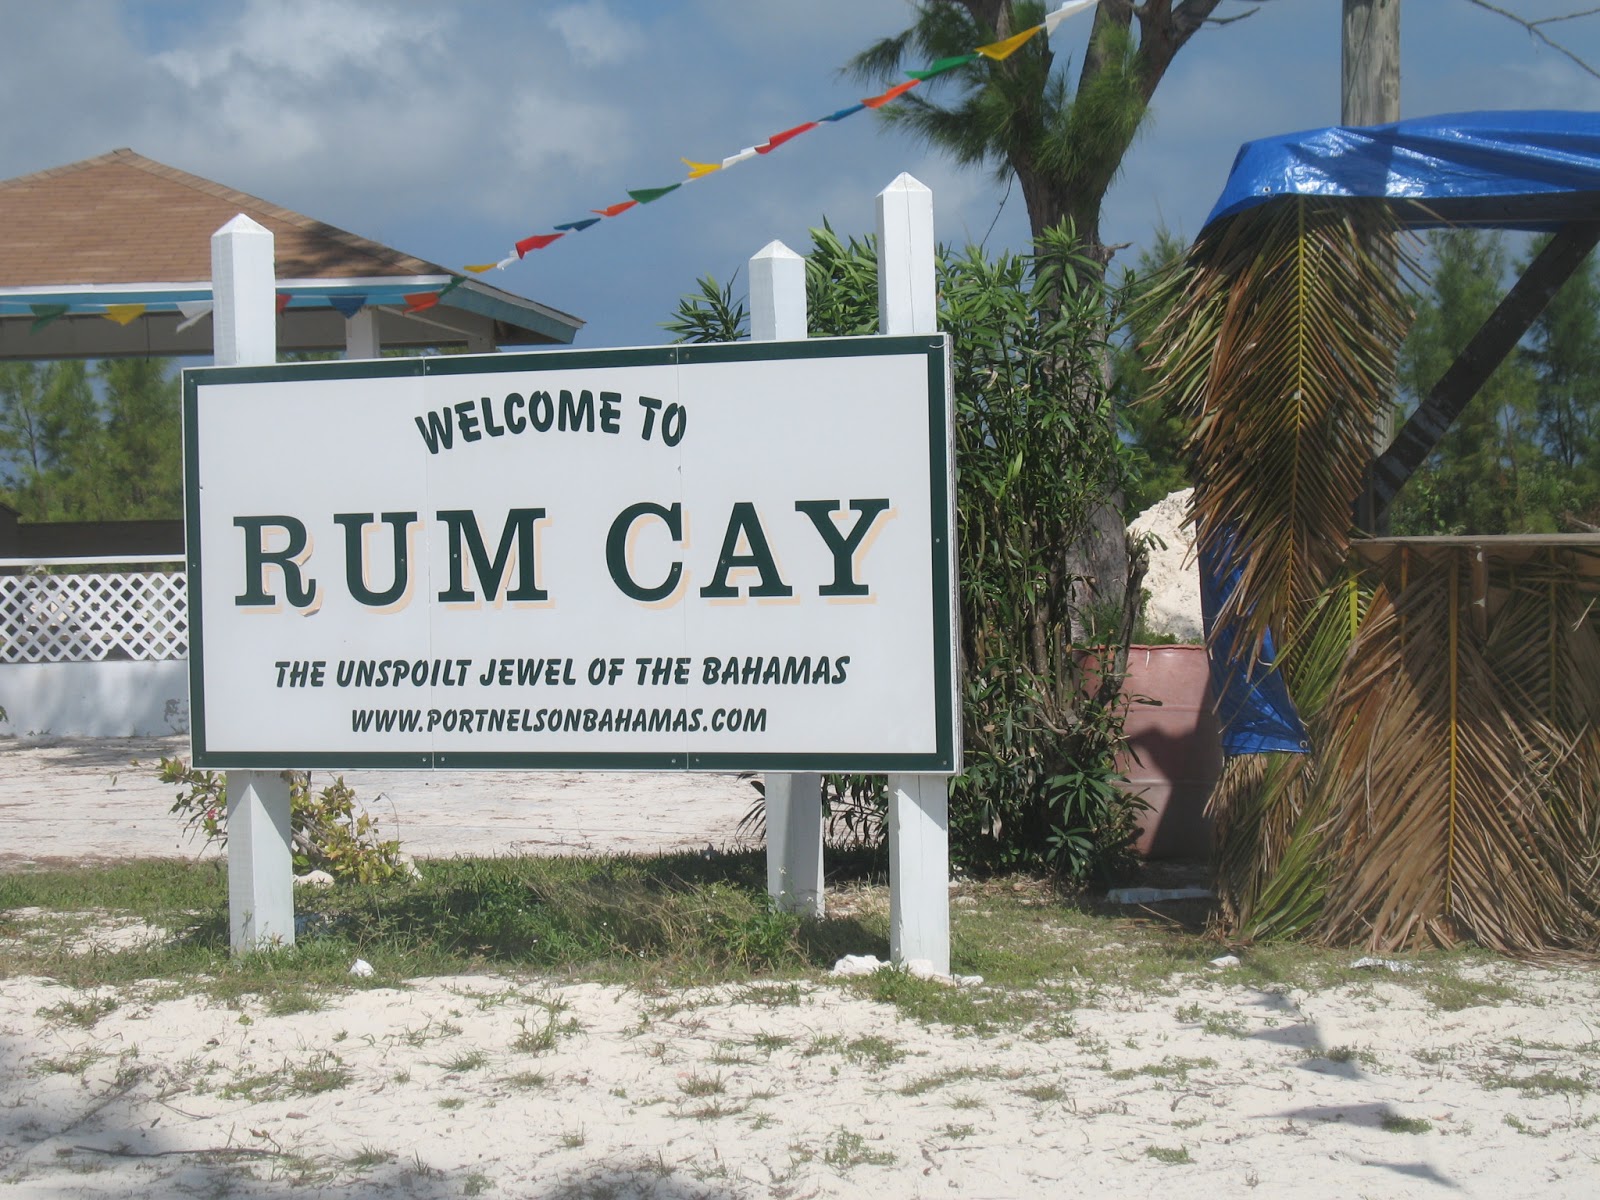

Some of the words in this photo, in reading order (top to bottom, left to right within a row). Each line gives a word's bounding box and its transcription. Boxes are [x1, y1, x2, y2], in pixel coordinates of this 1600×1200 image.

[414, 389, 623, 455] WELCOME
[638, 395, 688, 448] TO
[233, 507, 550, 609] RUM
[605, 498, 891, 603] CAY
[274, 660, 328, 688] THE
[336, 659, 473, 688] UNSPOILT
[479, 658, 578, 687] JEWEL
[587, 657, 625, 686] OF
[635, 657, 692, 686] THE
[702, 655, 851, 685] BAHAMAS
[352, 708, 767, 734] WWW.PORTNELSONBAHAMAS.COM
